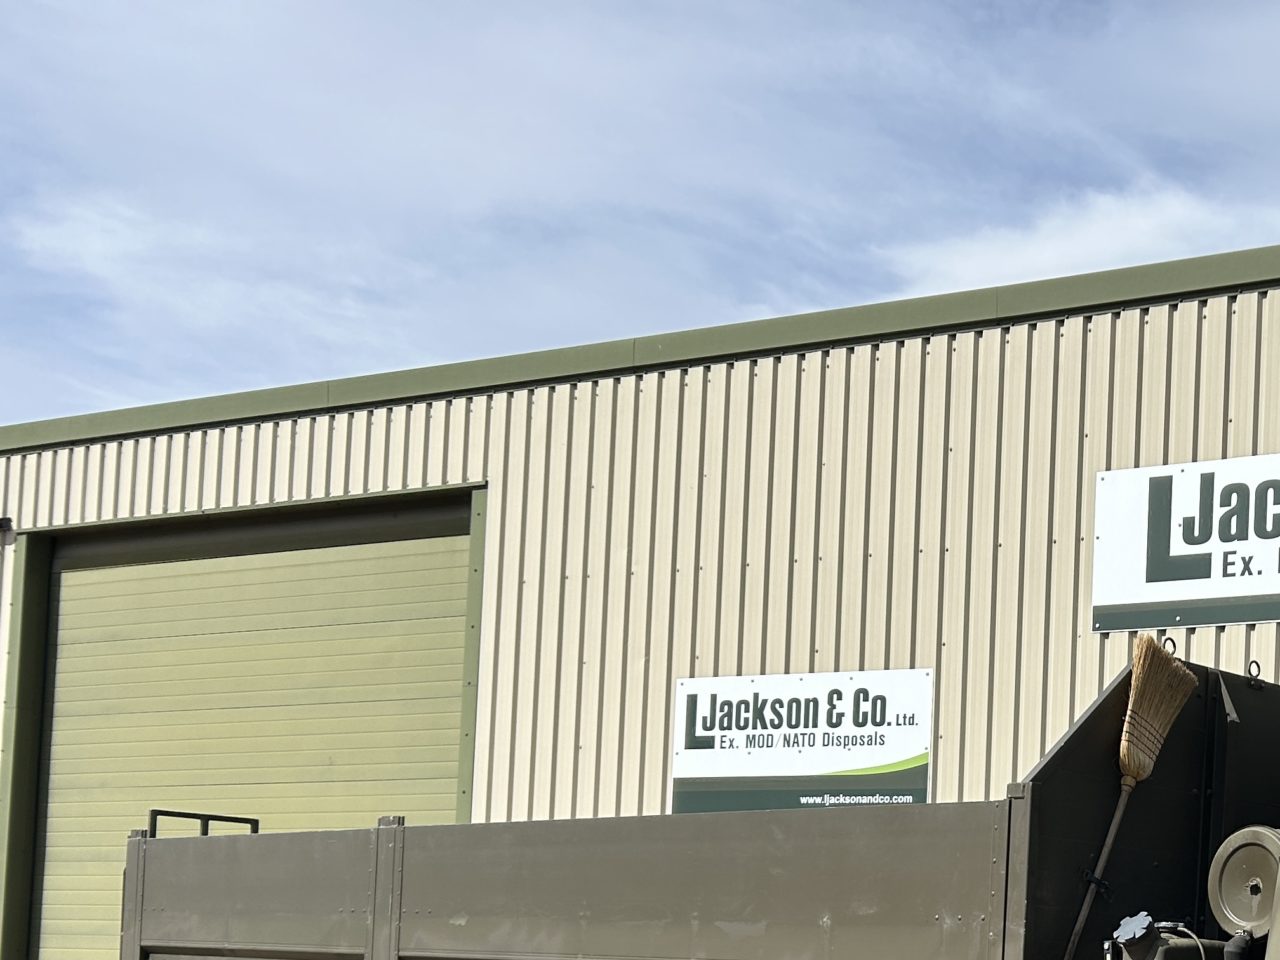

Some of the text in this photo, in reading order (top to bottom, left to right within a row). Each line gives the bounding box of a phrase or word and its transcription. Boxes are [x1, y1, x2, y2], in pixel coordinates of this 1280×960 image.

[1222, 550, 1263, 578] Ex.
[826, 688, 846, 729] &
[852, 687, 892, 727] Co.
[895, 712, 919, 727] Ltd.
[719, 731, 887, 750] Ex. MOD/NATO Disposals
[799, 793, 913, 807] www.ljacksonandco.com
